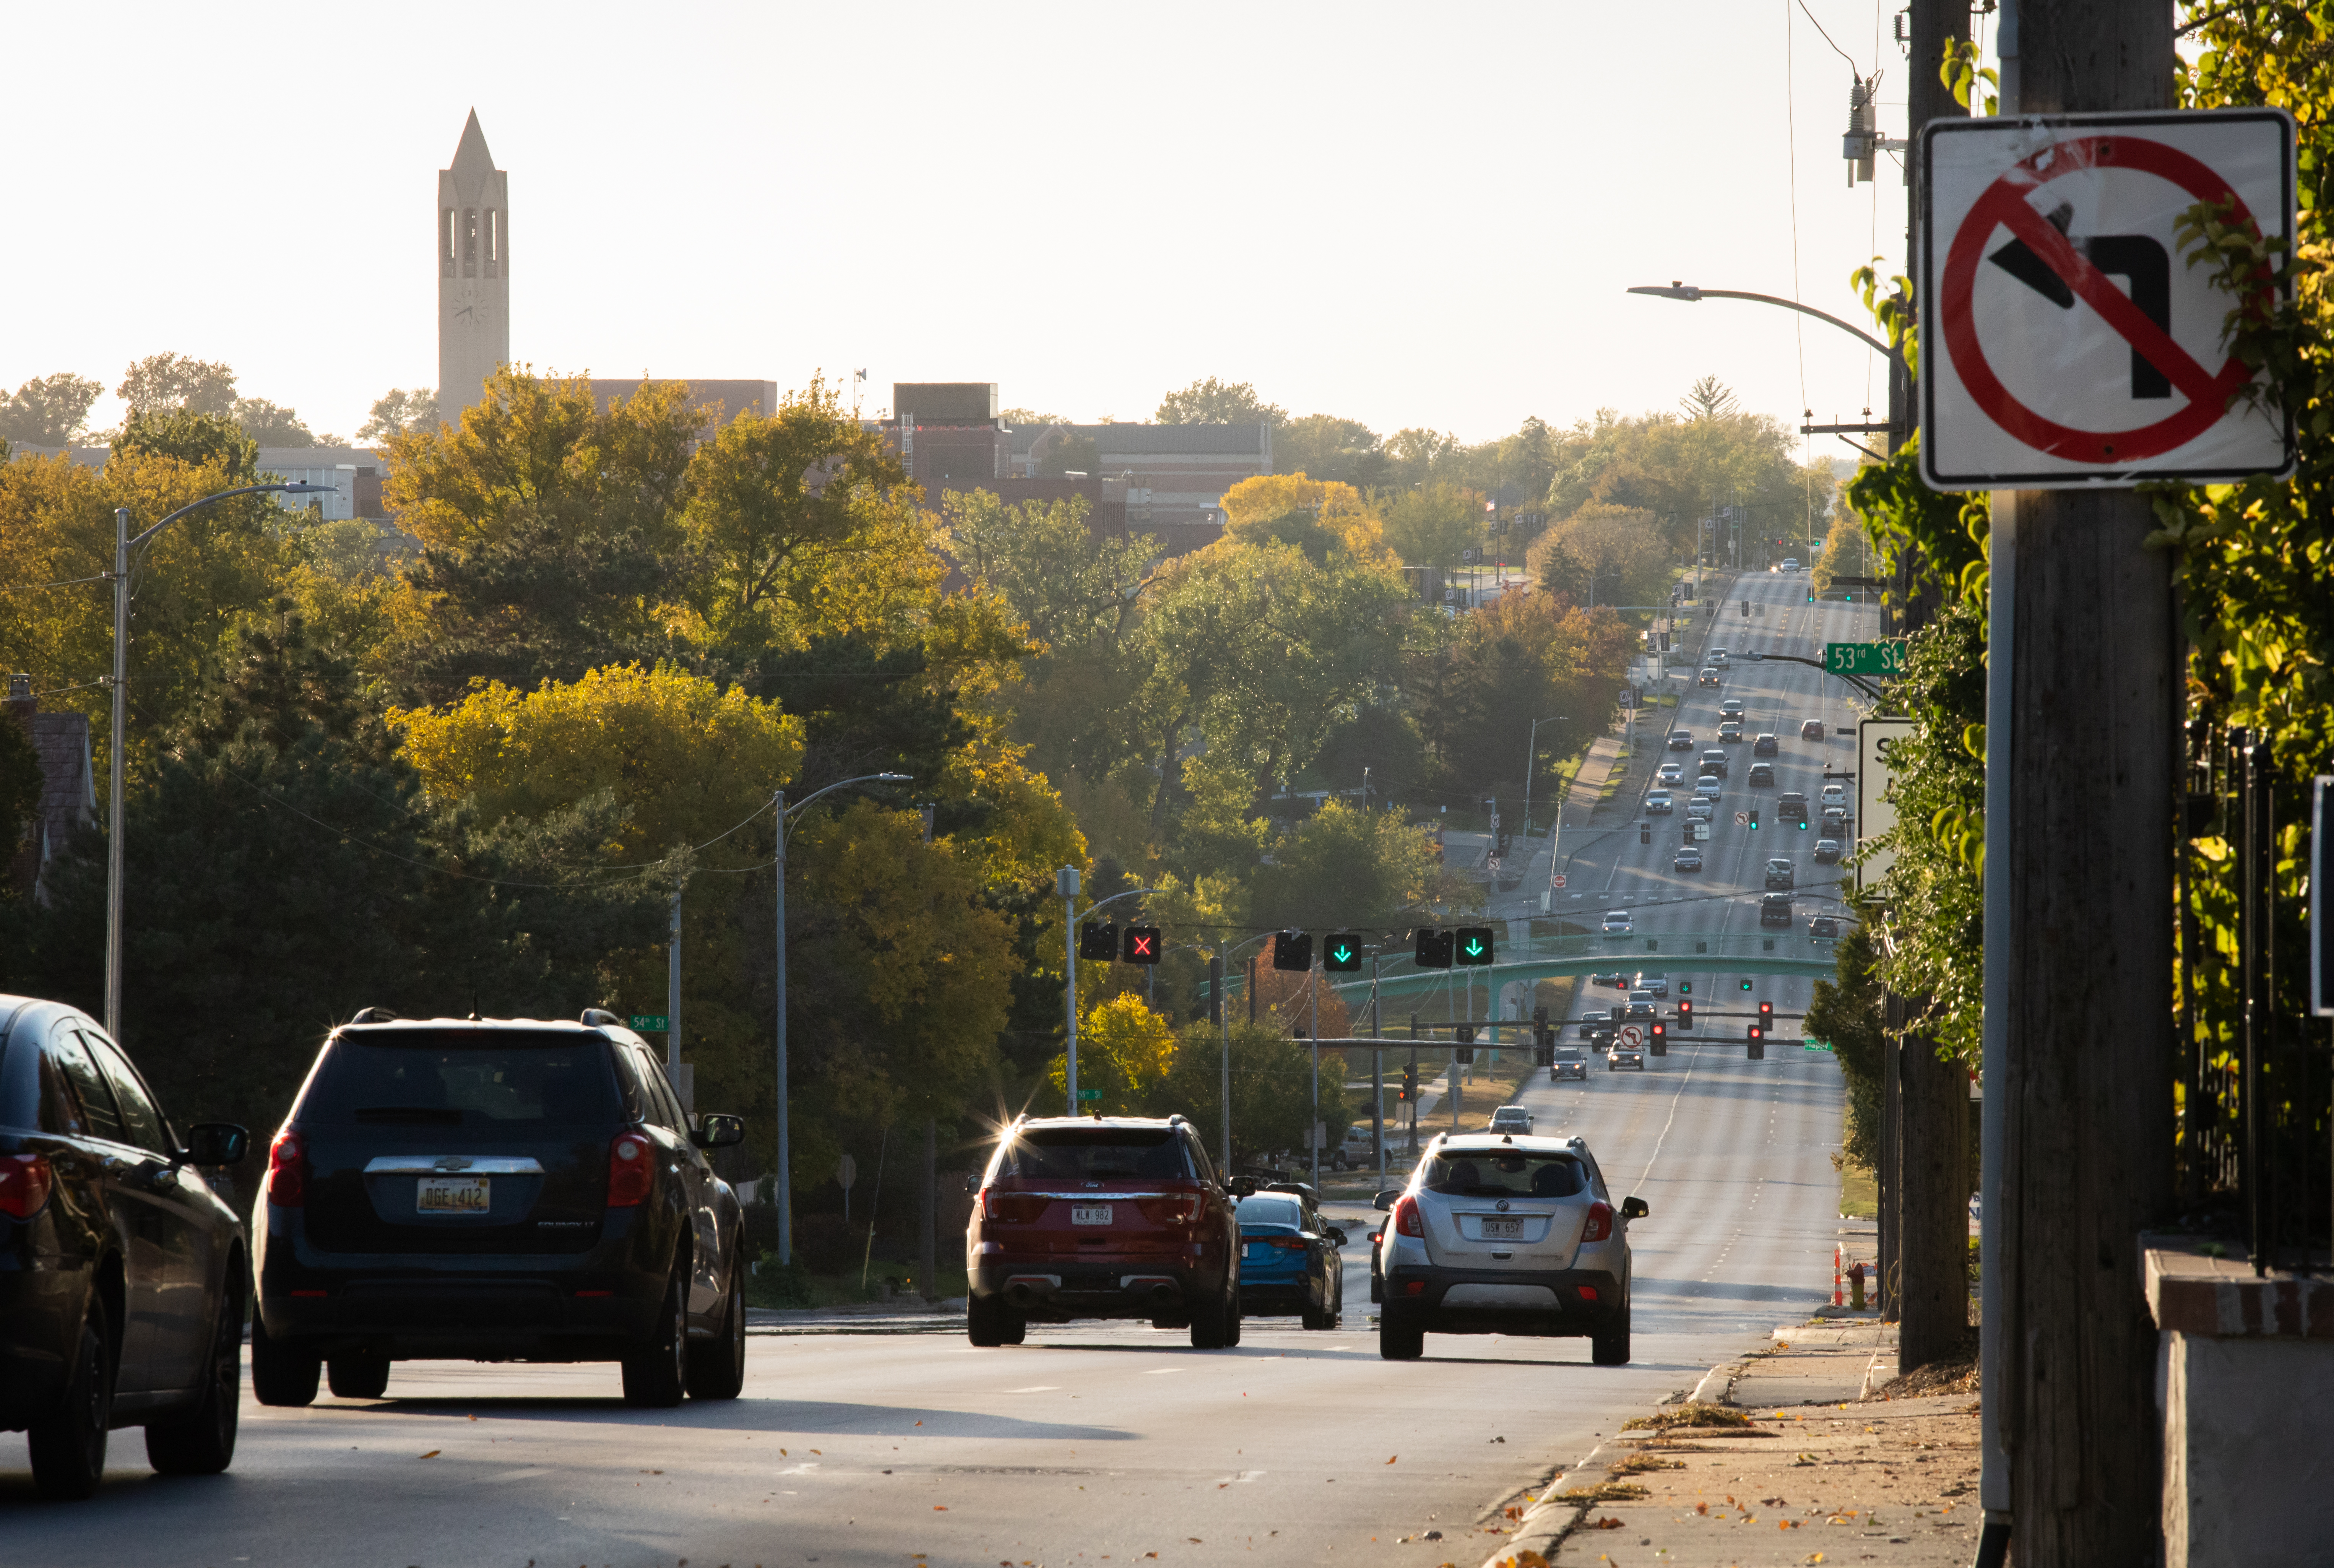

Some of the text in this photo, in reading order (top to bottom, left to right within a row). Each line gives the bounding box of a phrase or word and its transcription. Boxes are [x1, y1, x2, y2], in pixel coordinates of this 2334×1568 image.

[1835, 647, 1899, 669] 53rd St
[634, 1017, 665, 1028] 54th St
[458, 1188, 482, 1205] 412
[1076, 1210, 1109, 1220] WLW 982
[1486, 1223, 1519, 1233] USW 657
